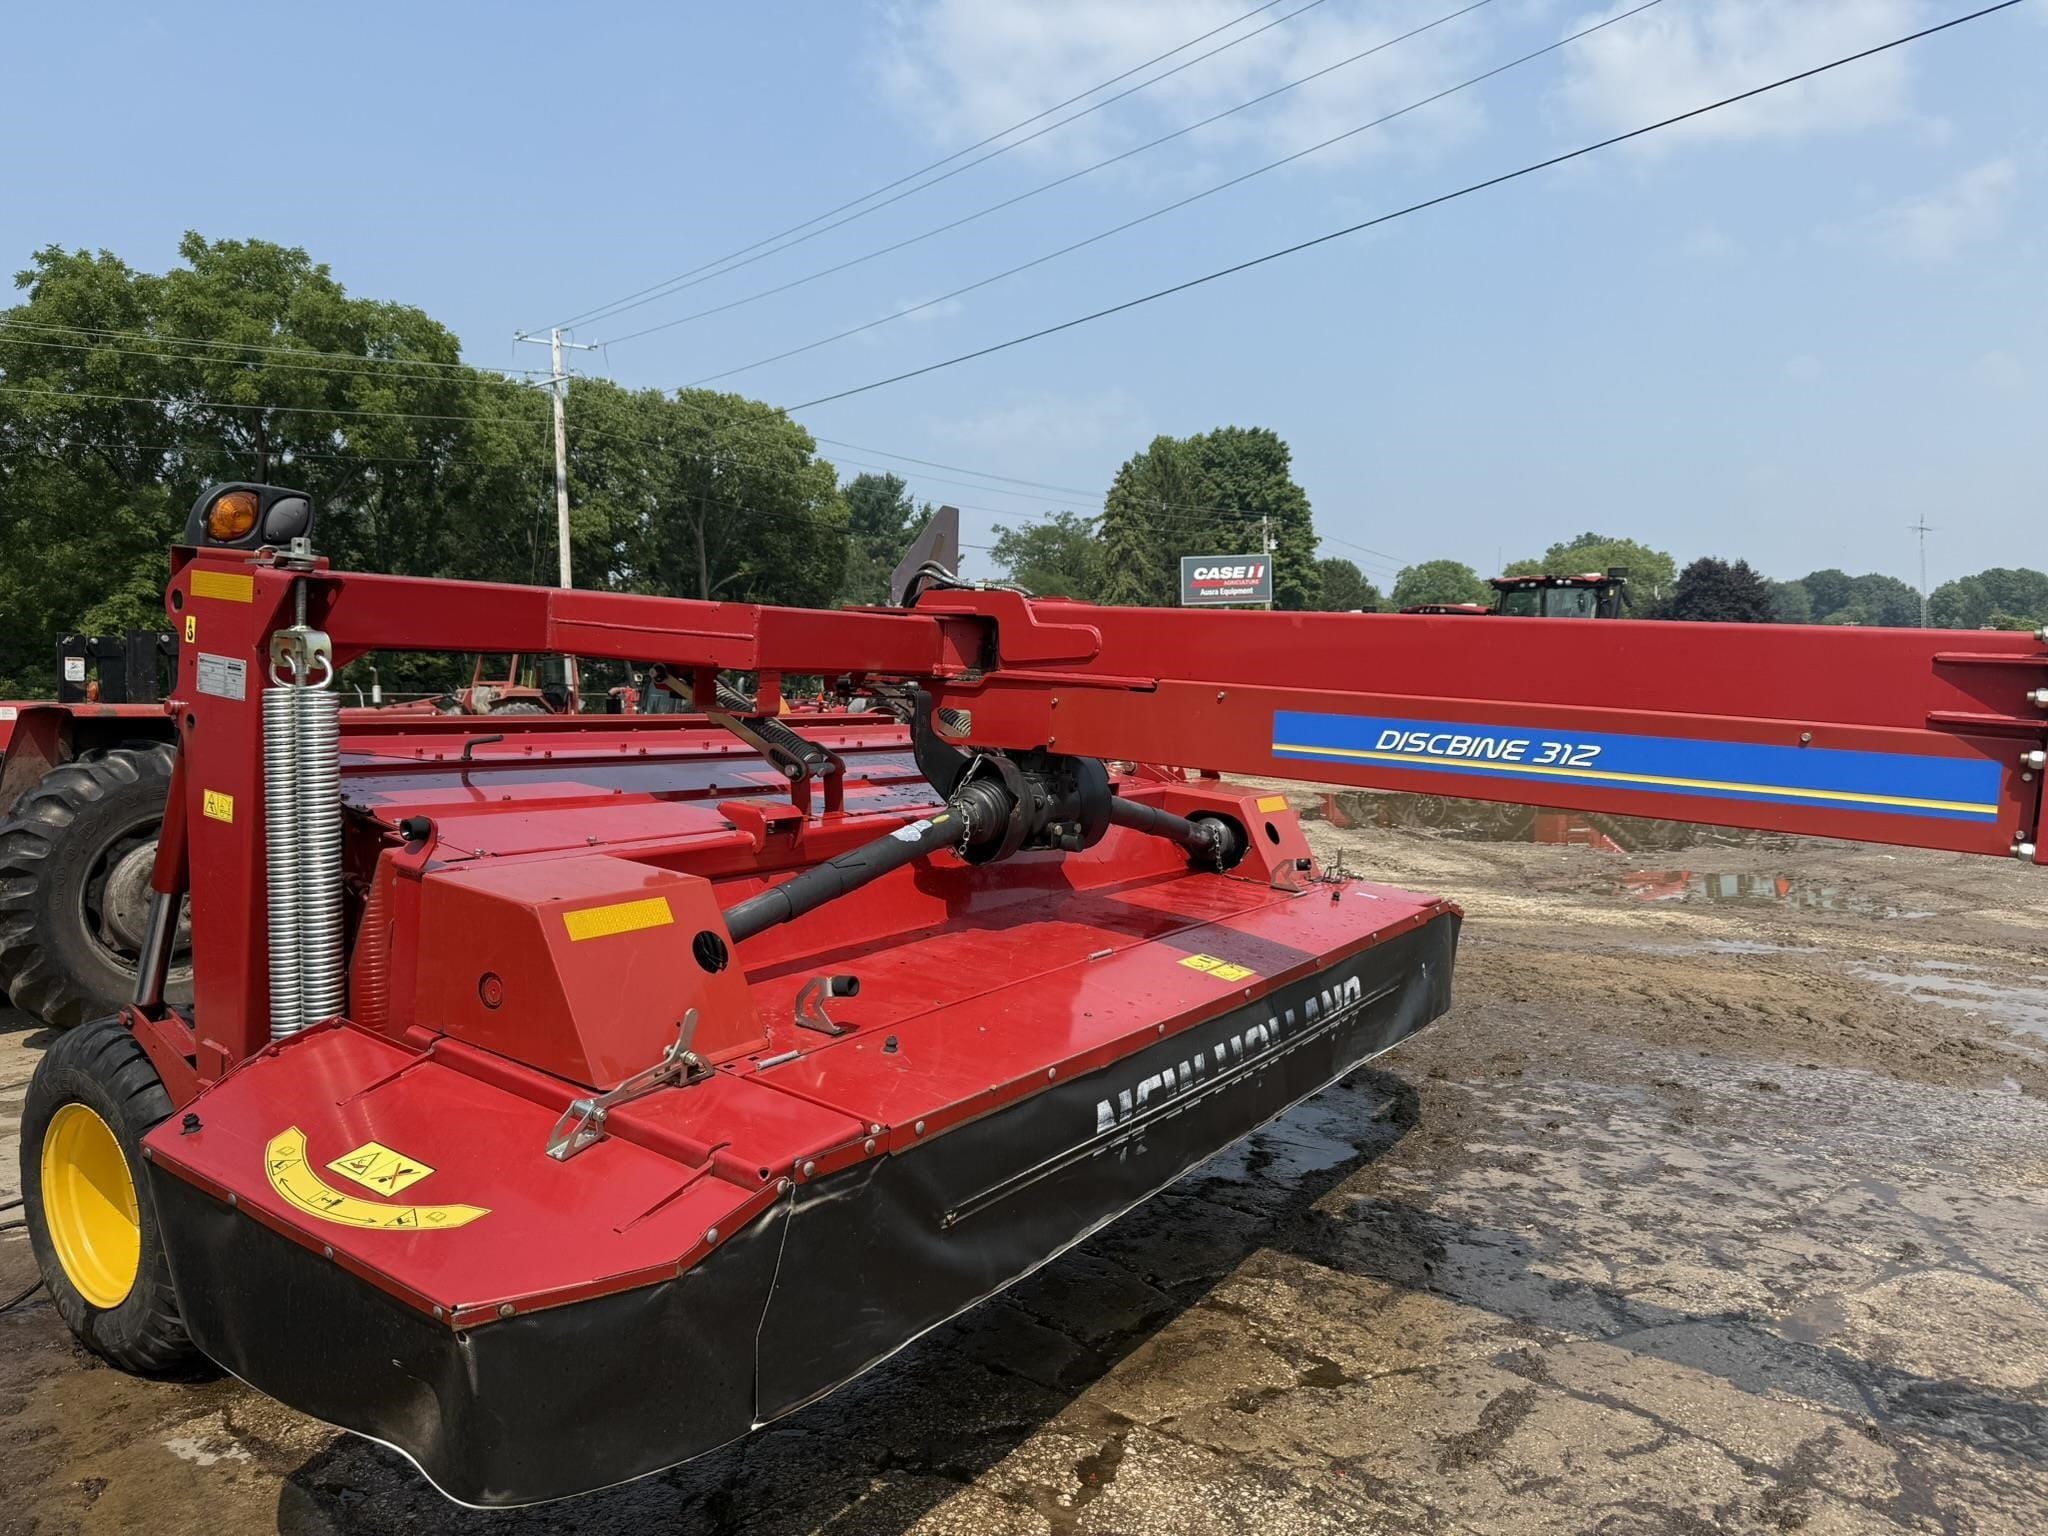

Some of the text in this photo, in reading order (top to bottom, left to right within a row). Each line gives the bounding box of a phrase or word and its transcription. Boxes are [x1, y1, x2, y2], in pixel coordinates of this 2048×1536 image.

[1194, 566, 1246, 580] CASE
[1220, 587, 1253, 596] Equipment
[1376, 730, 1601, 767] DISCBINE 312
